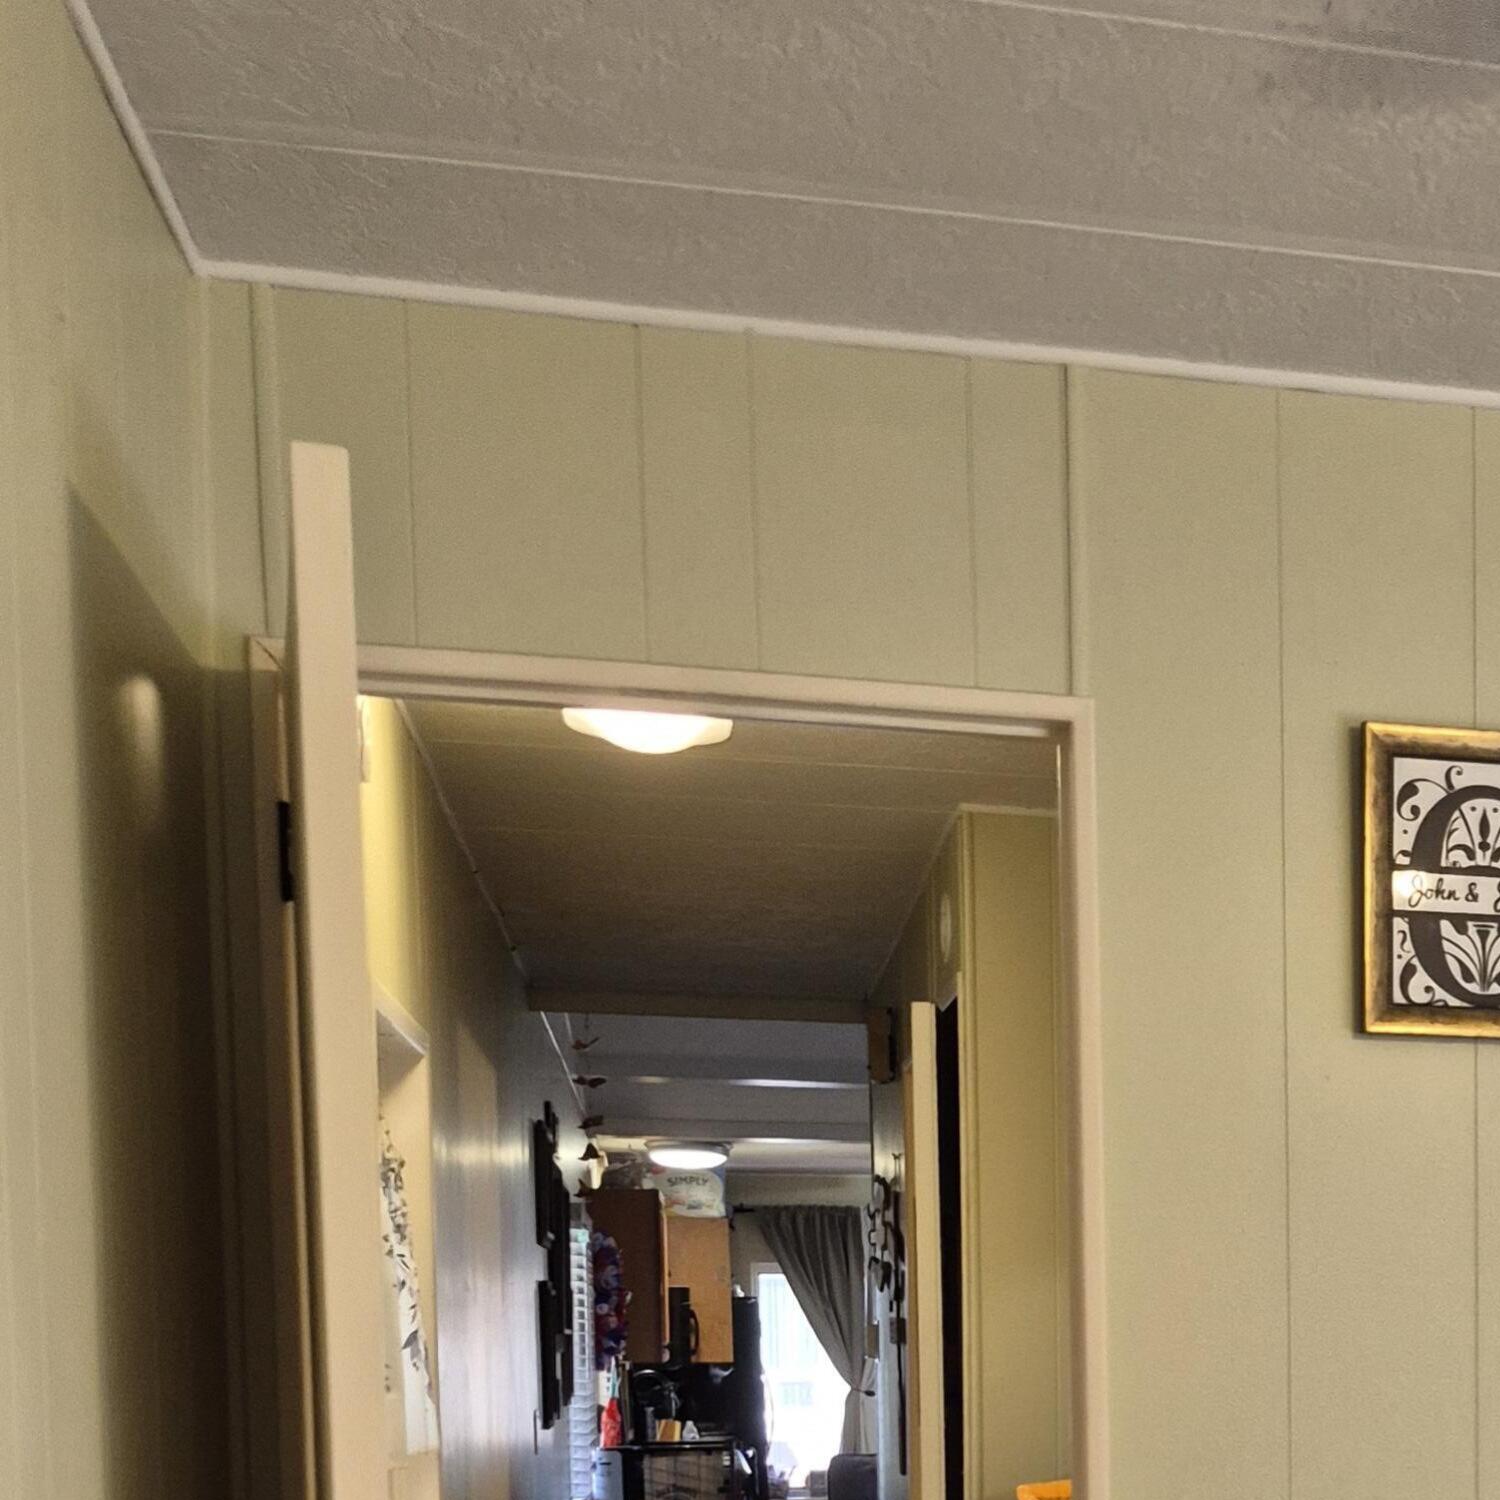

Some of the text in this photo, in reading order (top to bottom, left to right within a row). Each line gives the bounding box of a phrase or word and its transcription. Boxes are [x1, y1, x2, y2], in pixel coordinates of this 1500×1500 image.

[1408, 875, 1460, 908] John
[1465, 882, 1480, 904] &
[667, 1175, 710, 1188] SIMPLY
